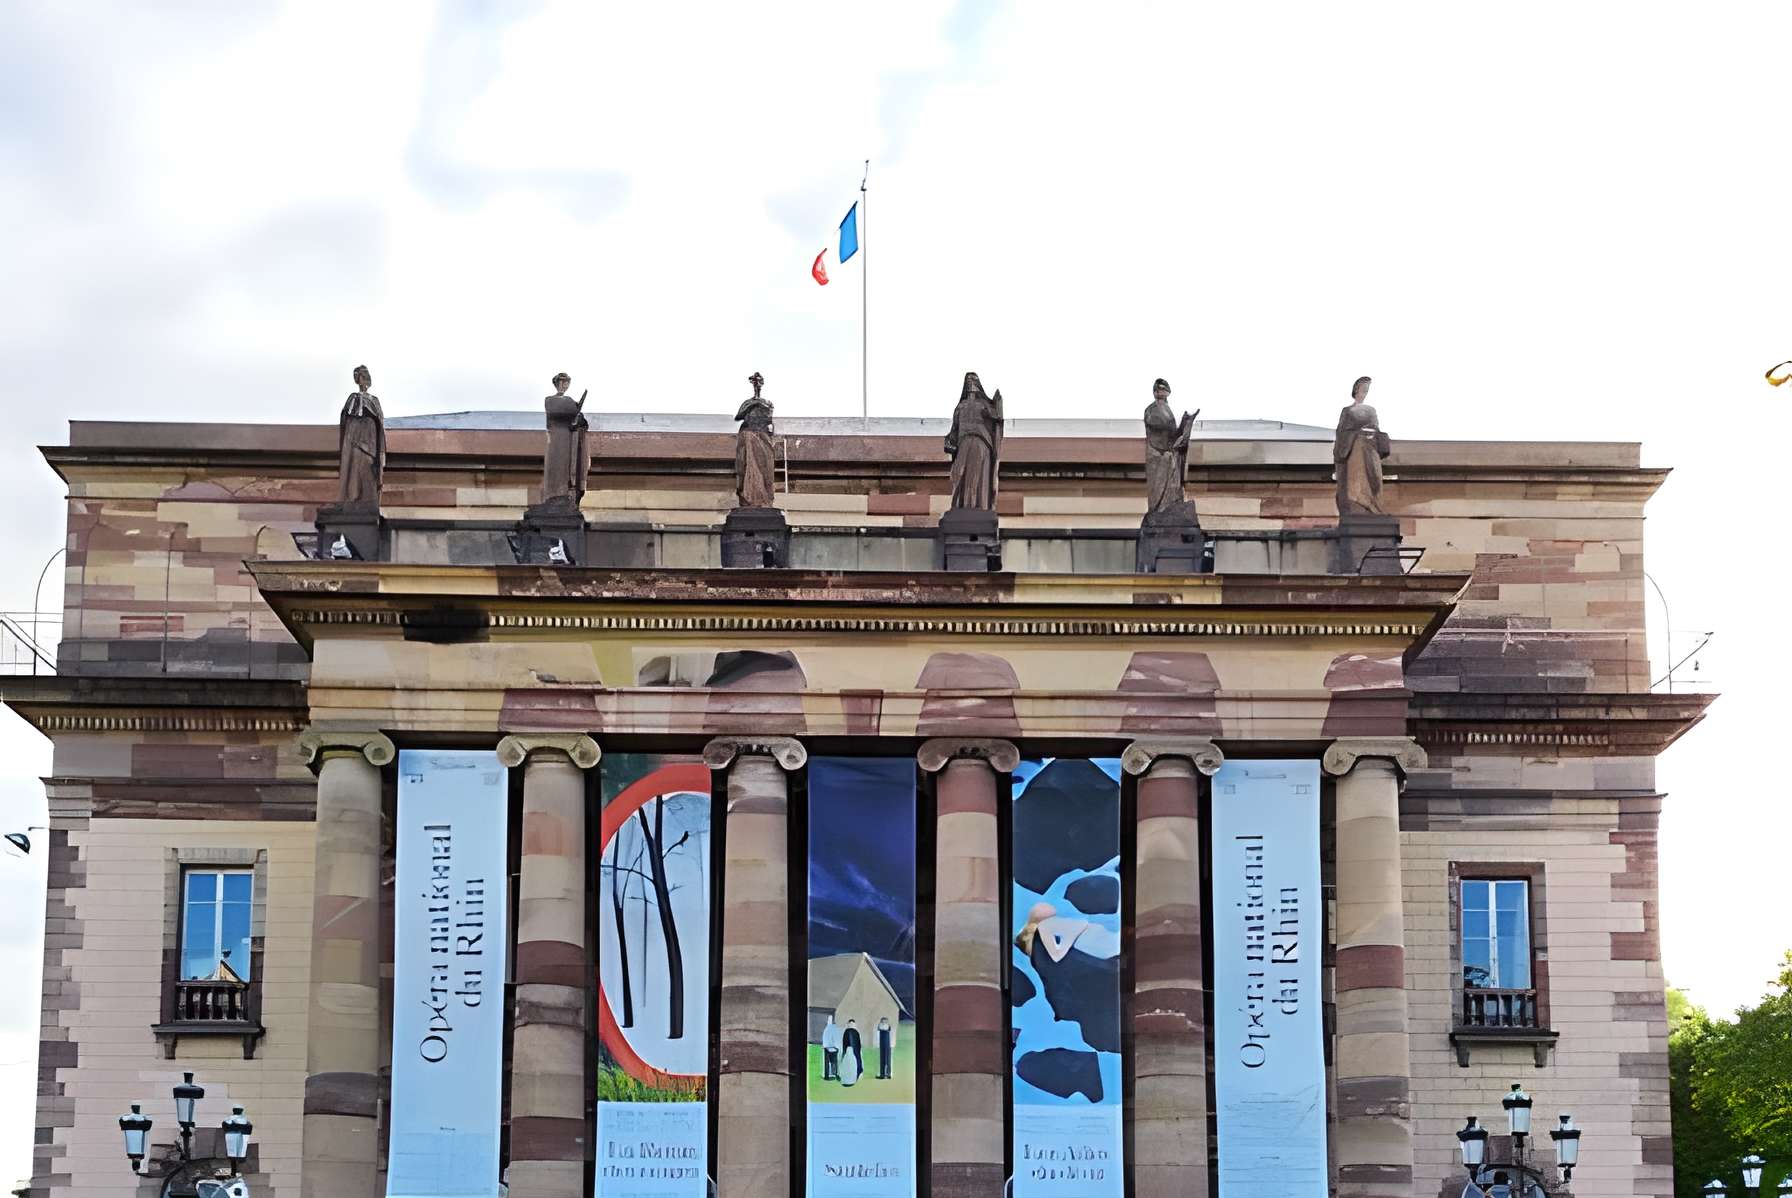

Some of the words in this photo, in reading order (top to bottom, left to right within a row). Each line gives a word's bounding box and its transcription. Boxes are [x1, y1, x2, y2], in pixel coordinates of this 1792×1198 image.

[455, 879, 484, 955] Rhin
[1271, 887, 1299, 964] Rhin
[455, 970, 482, 1007] du
[1271, 978, 1298, 1015] du
